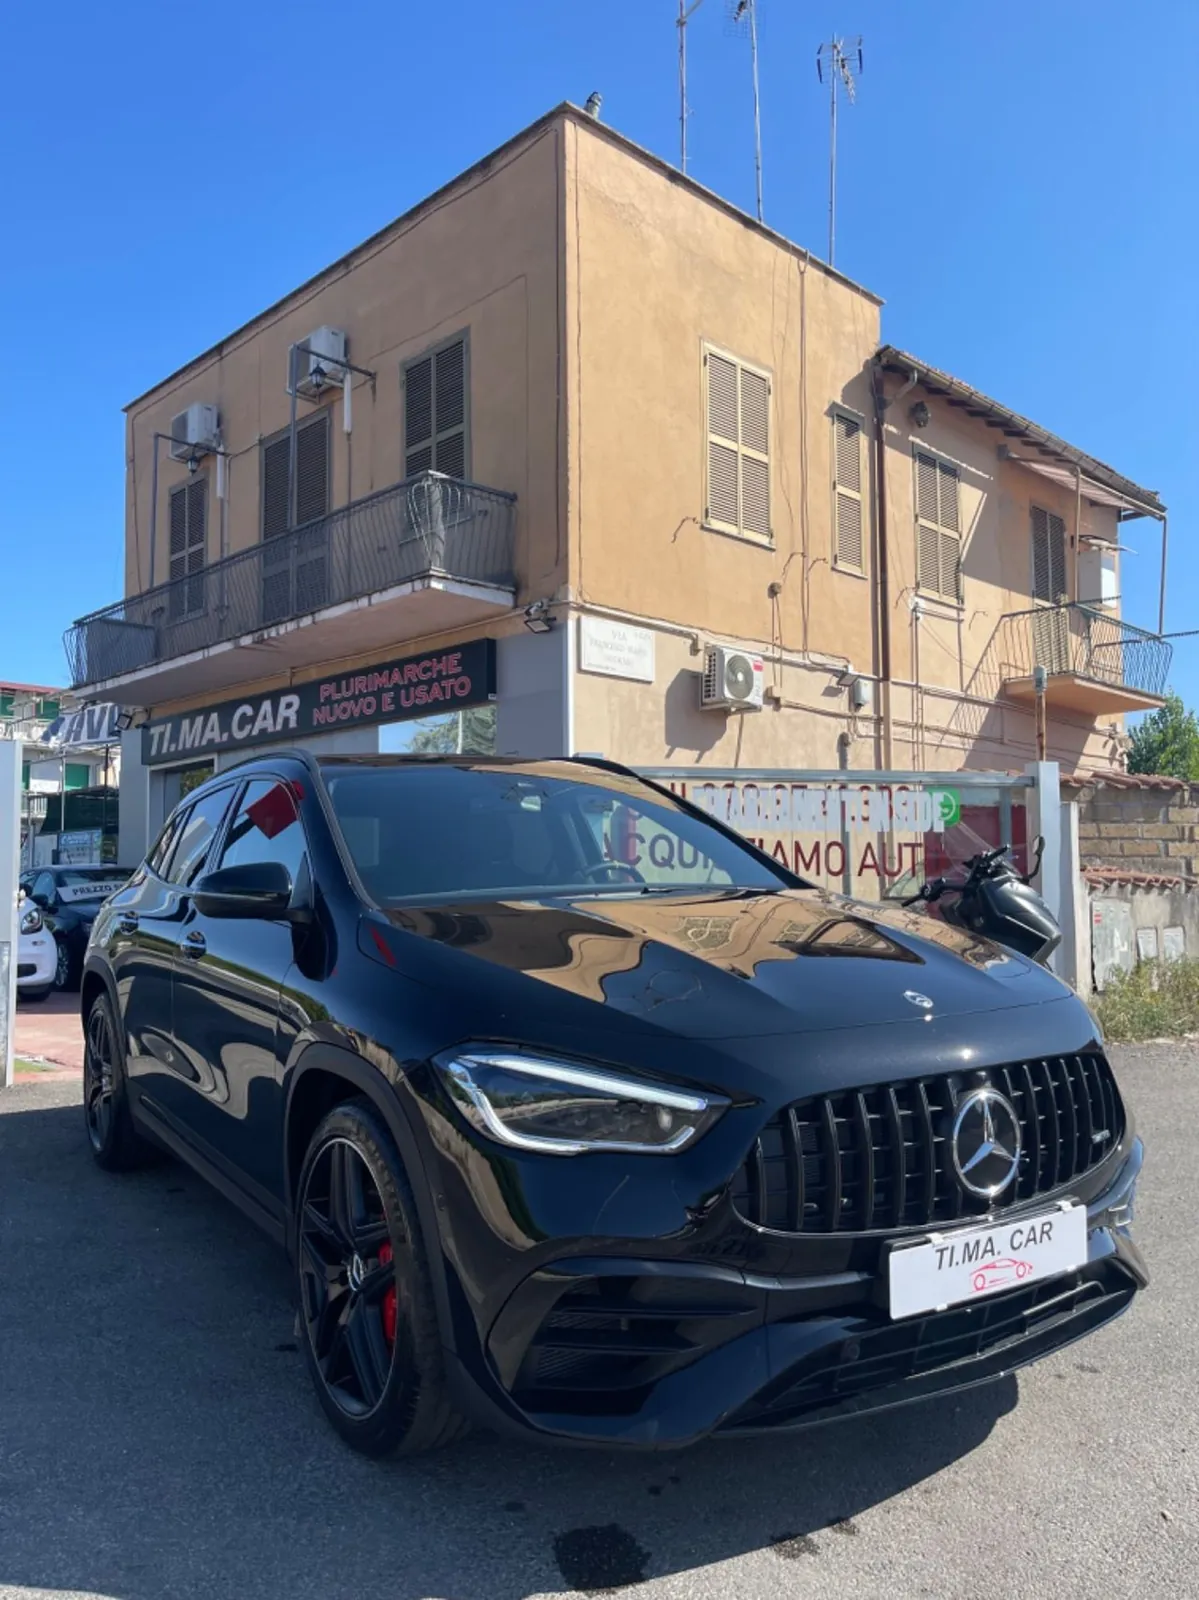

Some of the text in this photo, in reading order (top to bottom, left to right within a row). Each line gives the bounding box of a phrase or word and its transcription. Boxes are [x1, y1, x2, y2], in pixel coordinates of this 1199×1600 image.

[313, 675, 472, 725] NUOVO E USATO
[150, 694, 300, 757] TI.MA.CAR
[857, 840, 924, 877] AUT
[72, 884, 112, 896] PREZZO
[935, 1221, 1053, 1270] TI.MA. CAR
